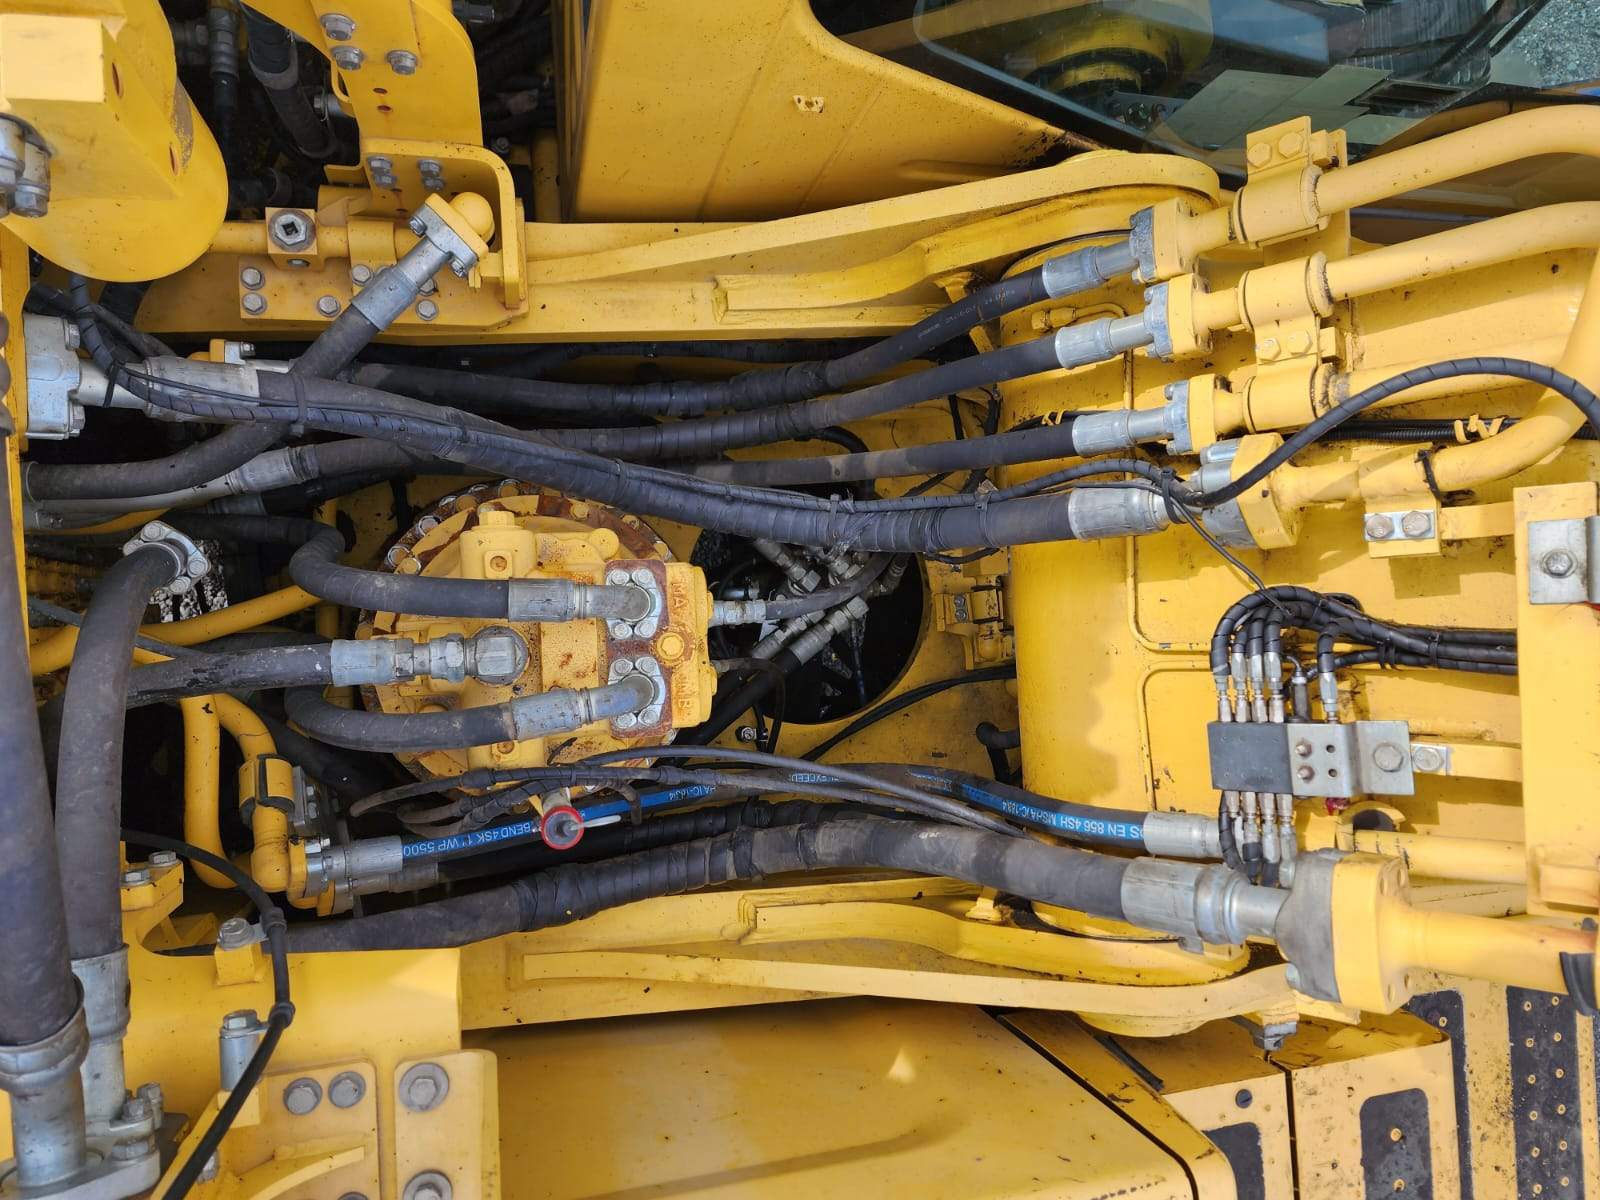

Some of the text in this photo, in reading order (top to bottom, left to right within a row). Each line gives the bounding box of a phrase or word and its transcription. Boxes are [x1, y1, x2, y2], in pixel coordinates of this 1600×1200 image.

[672, 583, 689, 608] MA
[1031, 808, 1057, 826] MSHA
[1060, 817, 1082, 830] 4SH
[501, 822, 531, 838] BEND
[1084, 821, 1104, 834] 856
[1108, 824, 1126, 837] EN
[480, 831, 500, 843] 4SK
[403, 842, 435, 857] 5500
[438, 838, 457, 850] WP
